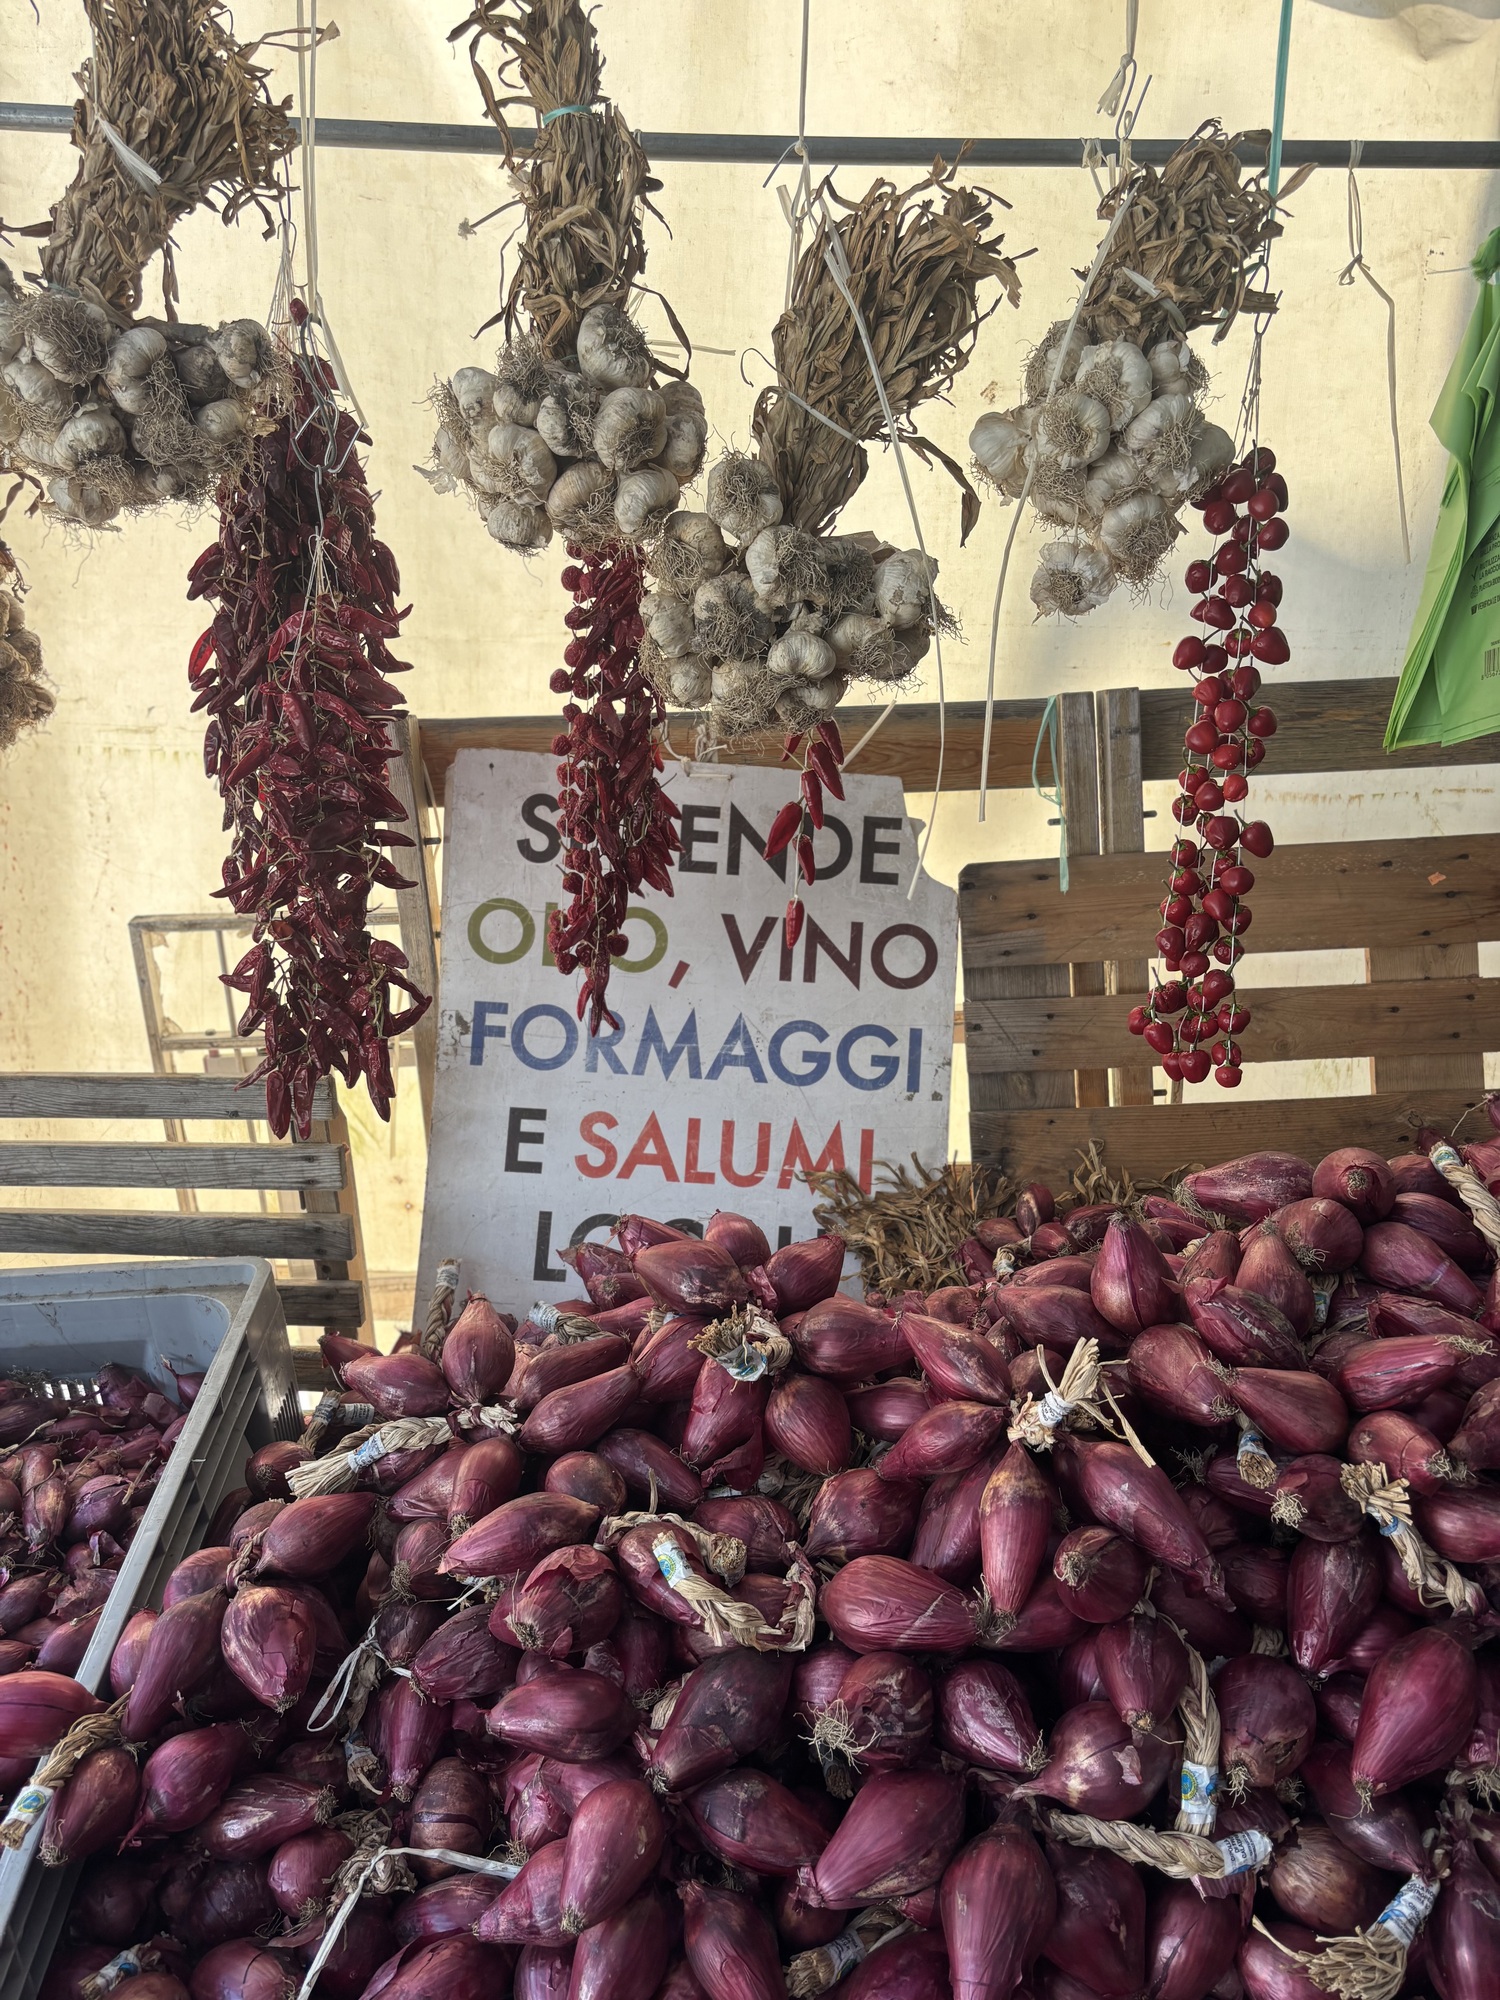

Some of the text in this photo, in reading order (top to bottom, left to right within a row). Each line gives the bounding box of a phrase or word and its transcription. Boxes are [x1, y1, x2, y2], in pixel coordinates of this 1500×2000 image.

[648, 801, 904, 886] ENDE
[467, 897, 939, 991] OO, VINO
[469, 1000, 923, 1094] FORMAGGI
[504, 1106, 875, 1196] E SALUMI
